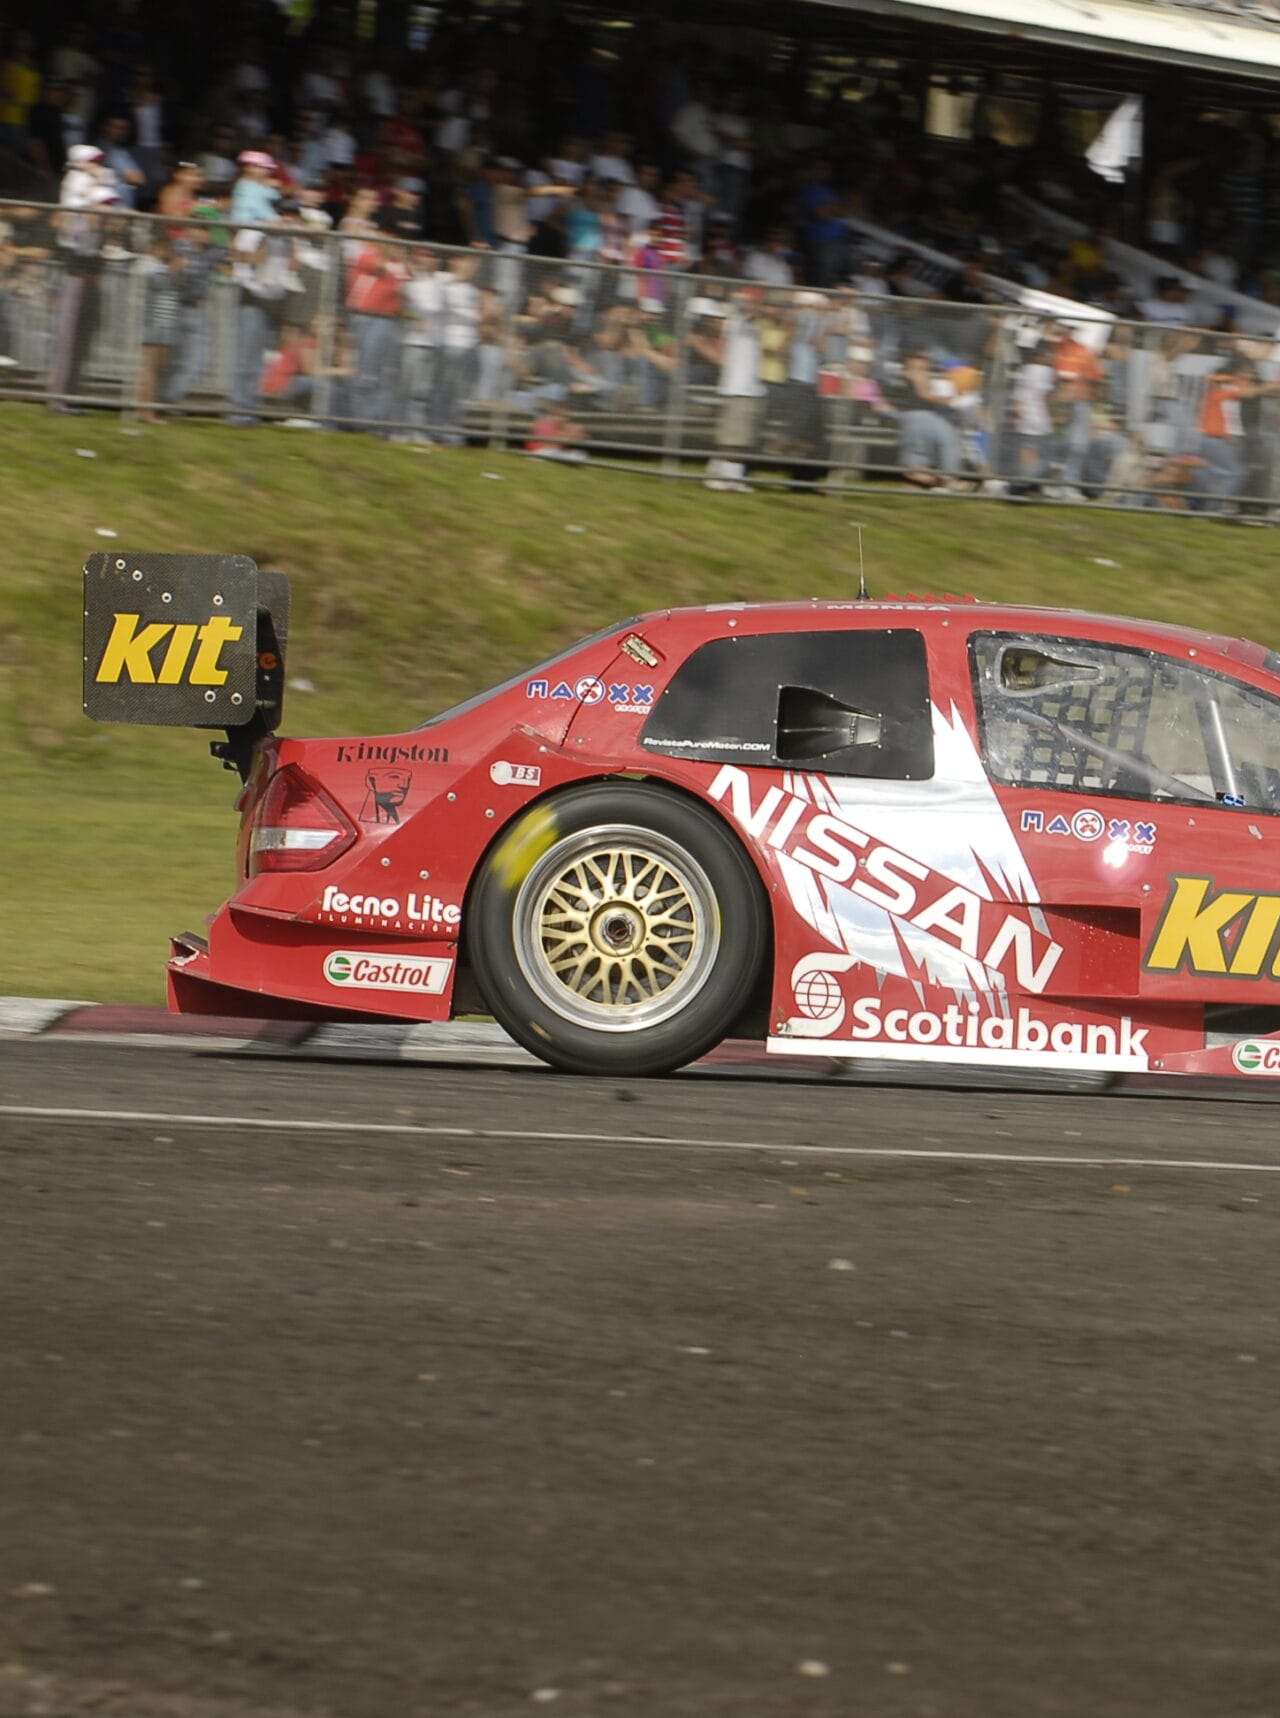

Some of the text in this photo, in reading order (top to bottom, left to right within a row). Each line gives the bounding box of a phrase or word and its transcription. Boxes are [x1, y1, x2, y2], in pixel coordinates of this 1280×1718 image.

[336, 742, 449, 764] Kingston
[706, 764, 1064, 994] NISSAN
[322, 885, 462, 924] Tecno Lite
[317, 912, 454, 933] ILUMINACIÓN
[353, 959, 433, 987] Castrol
[850, 997, 1151, 1056] Scotiabank
